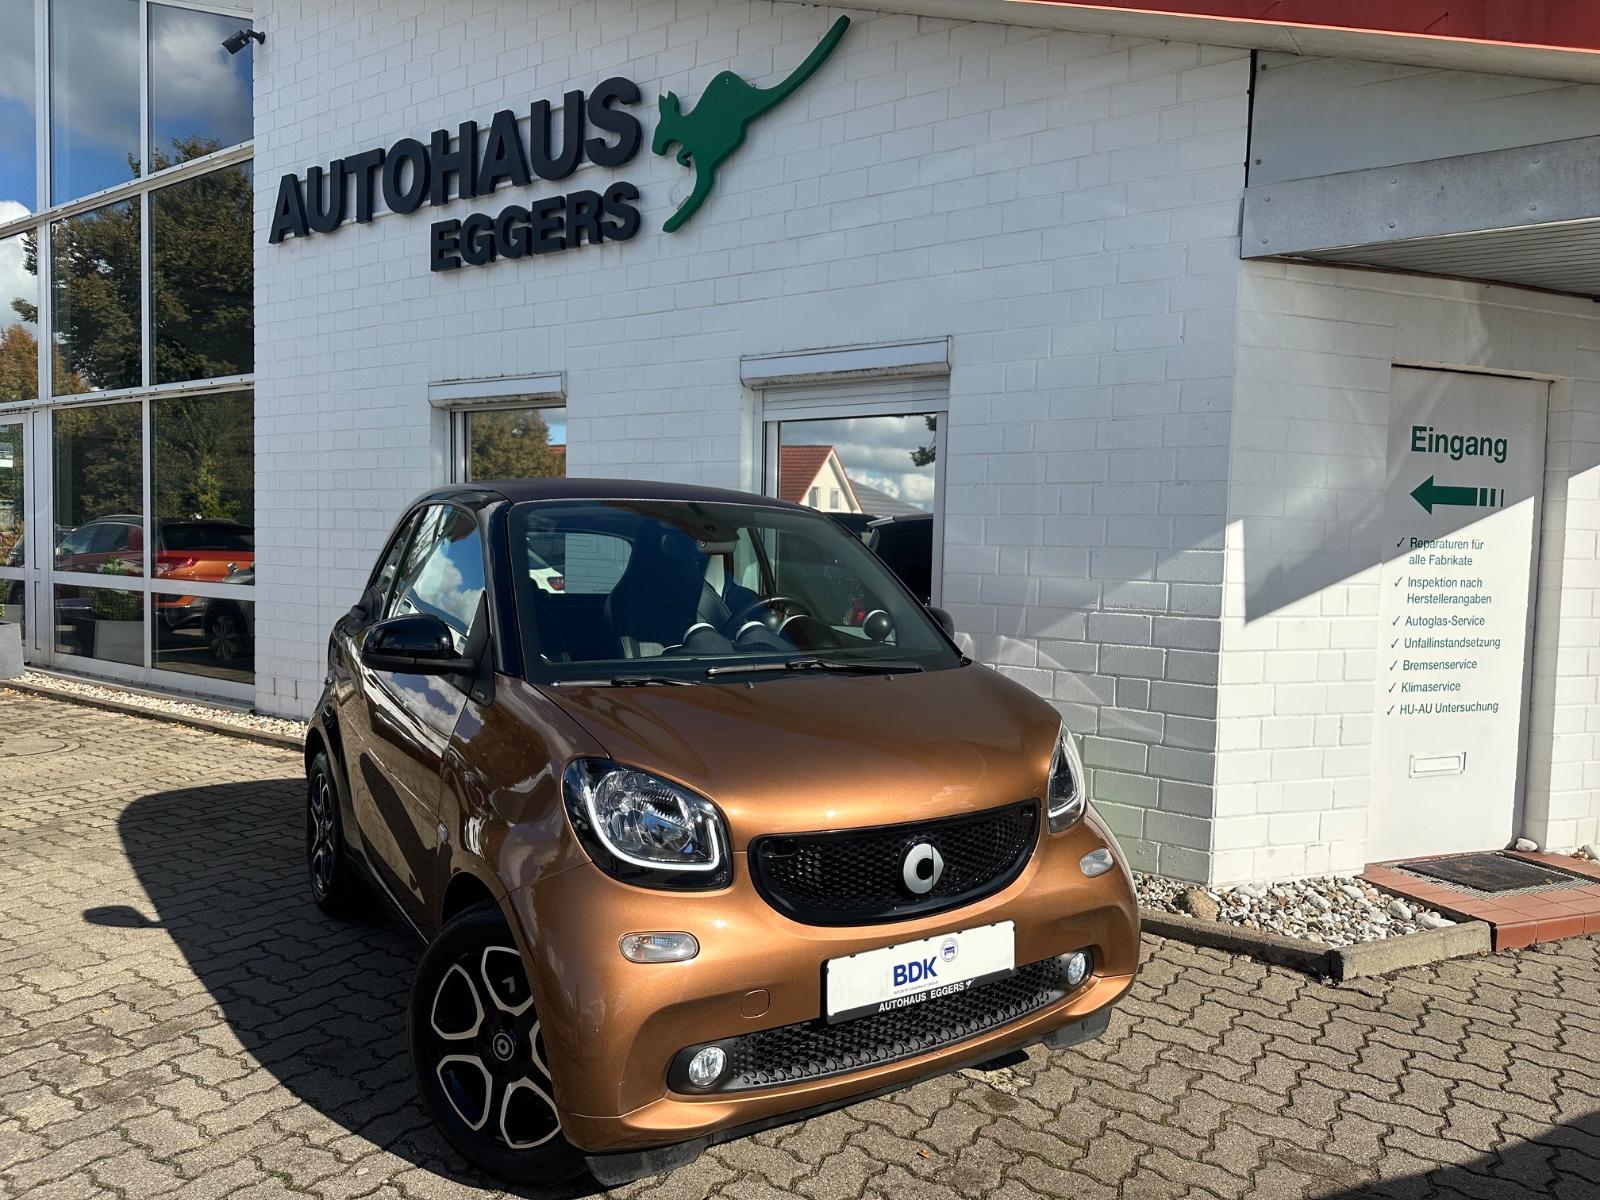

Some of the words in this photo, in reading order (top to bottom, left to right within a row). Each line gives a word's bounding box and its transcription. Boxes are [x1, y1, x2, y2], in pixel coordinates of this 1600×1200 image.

[268, 76, 642, 244] AUTOHAUS
[430, 181, 641, 272] EGGERS
[1411, 425, 1508, 464] Eingang
[1410, 537, 1468, 551] Reparaturen
[1471, 538, 1484, 550] für
[1408, 554, 1427, 565] alle
[1429, 554, 1473, 566] Fabrikate
[1407, 576, 1457, 590] Inspektion
[1460, 577, 1483, 588] nach
[1407, 593, 1492, 606] Herstellerangaben
[1405, 615, 1485, 628] Autoglas-Service
[1404, 637, 1501, 650] Unfallinstandsetzung
[1402, 659, 1478, 671] Bremsenservice
[1401, 681, 1461, 693] Klimaservice
[1399, 703, 1433, 715] HU-AU
[1435, 701, 1499, 714] Untersuchung
[893, 956, 938, 987] BDK
[878, 992, 927, 1012] AUTOHAUS
[930, 982, 965, 999] EGGERS
